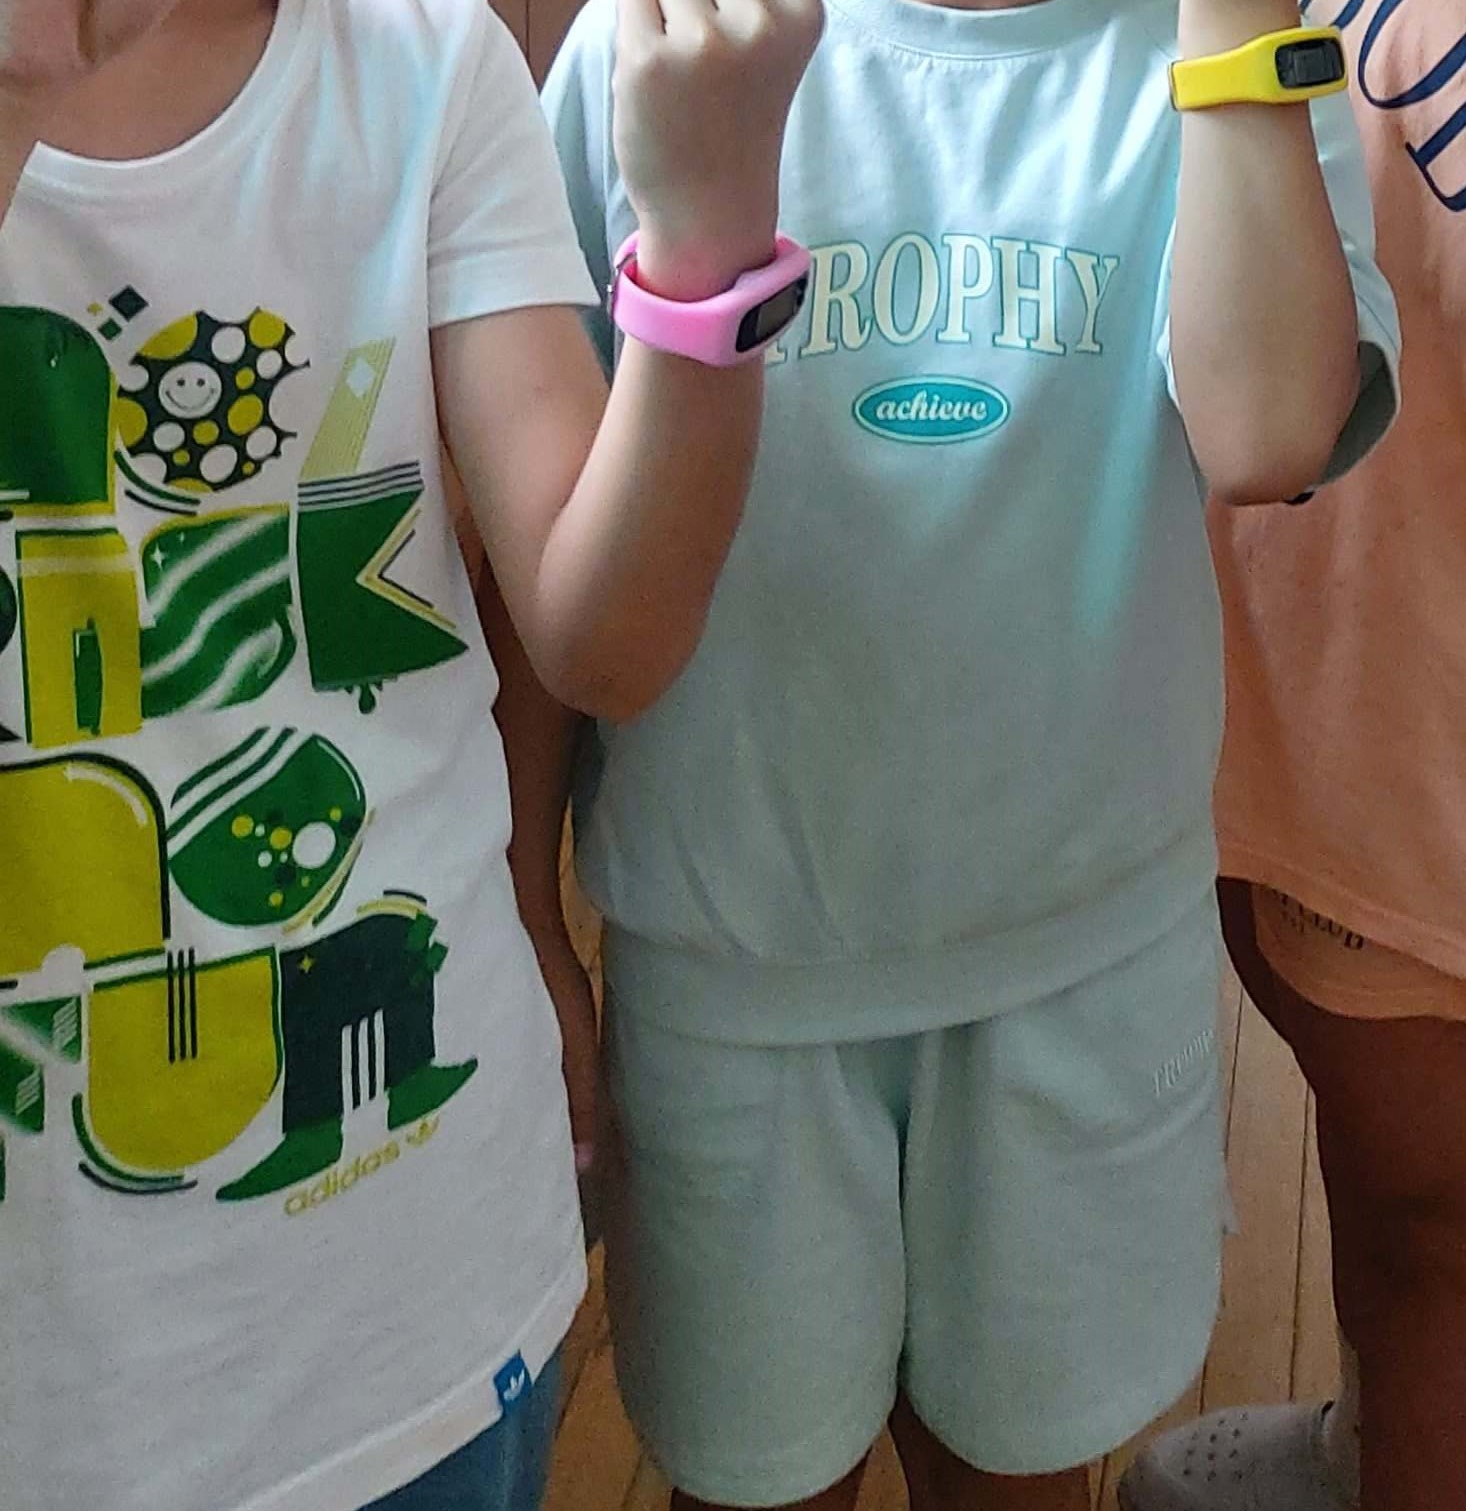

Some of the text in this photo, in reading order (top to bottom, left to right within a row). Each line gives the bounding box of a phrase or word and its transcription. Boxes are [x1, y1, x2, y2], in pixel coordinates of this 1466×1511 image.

[764, 232, 1122, 365] ROPHY
[875, 389, 988, 421] achieve
[284, 1141, 400, 1217] adidas
